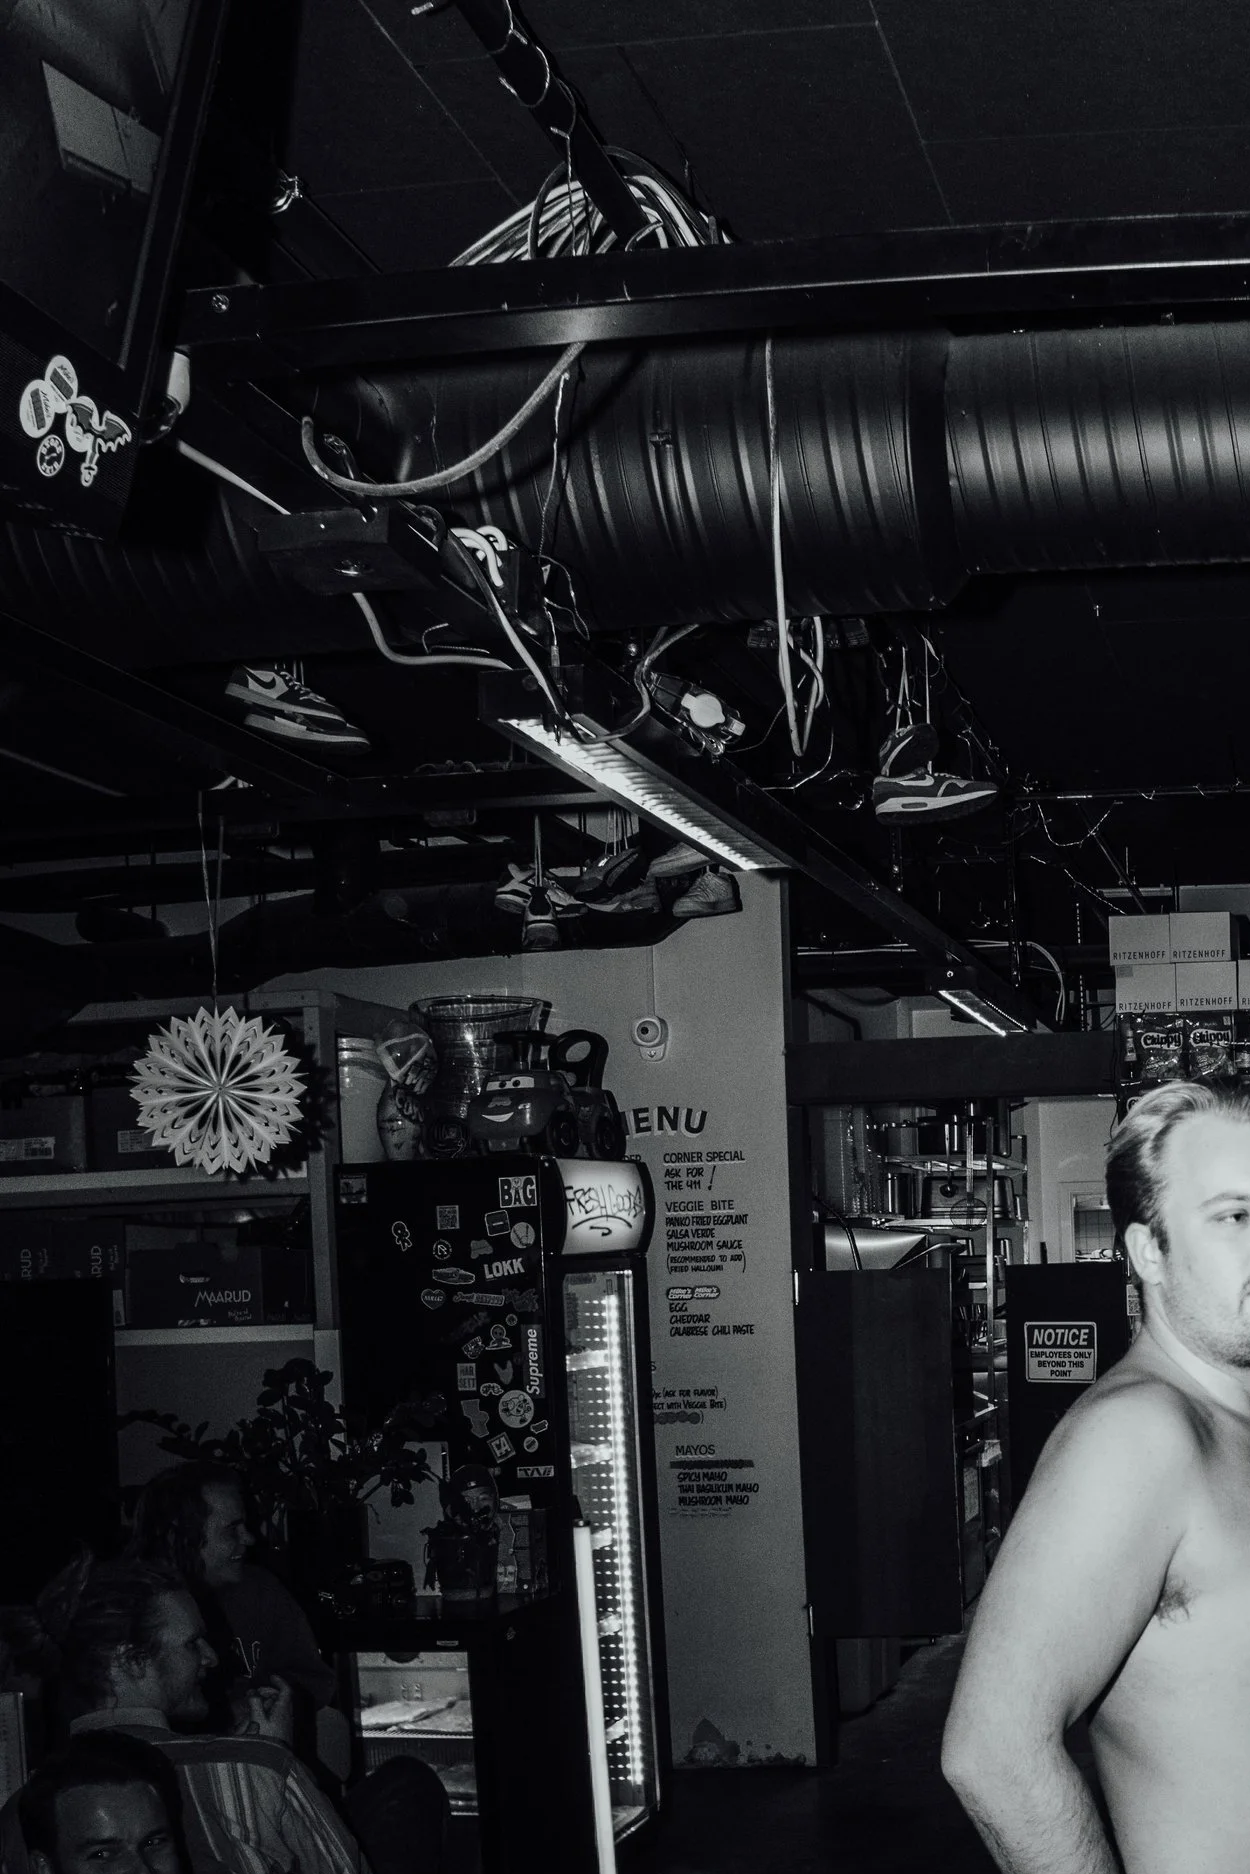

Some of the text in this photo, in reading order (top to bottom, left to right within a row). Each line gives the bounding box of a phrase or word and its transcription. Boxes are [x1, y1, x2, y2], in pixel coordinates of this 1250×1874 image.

[1113, 951, 1165, 960] RITZENHOFF
[1173, 949, 1225, 958] RITZENHOFF
[1119, 1002, 1172, 1010] RITZENHOFF
[1180, 997, 1233, 1006] RITZENHOFF
[663, 1151, 745, 1163] CORNER SPECIAL
[664, 1167, 704, 1178] ASK FOR
[665, 1181, 683, 1190] THE
[686, 1180, 701, 1190] 411
[665, 1200, 734, 1212] VEGGIE BITE
[665, 1214, 748, 1227] PANKO FRIED EGGPLANT
[666, 1228, 715, 1239] SALSA VERDE
[667, 1240, 743, 1251] MUSHROOM SAUCE
[483, 1257, 525, 1280] LOKK
[194, 1290, 252, 1308] MAARUD
[669, 1302, 687, 1312] EGG
[670, 1314, 711, 1324] CHEDDAR
[670, 1324, 755, 1337] CALABRESE CHILI PASTE
[1033, 1328, 1089, 1345] NOTICE
[1030, 1351, 1092, 1359] EMPLOYEES ONLY
[526, 1328, 544, 1395] Supreme
[1037, 1360, 1085, 1368] BEYOND THIS
[1050, 1369, 1072, 1377] POINT
[679, 1389, 691, 1398] FOR
[652, 1402, 664, 1410] ECT
[667, 1402, 682, 1410] WITH
[675, 1444, 715, 1456] MAYOS
[677, 1471, 727, 1482] SPICY MAYO
[678, 1484, 694, 1493] THAI
[735, 1483, 759, 1492] MAYO
[678, 1495, 749, 1506] MUSHROOM MAYO
